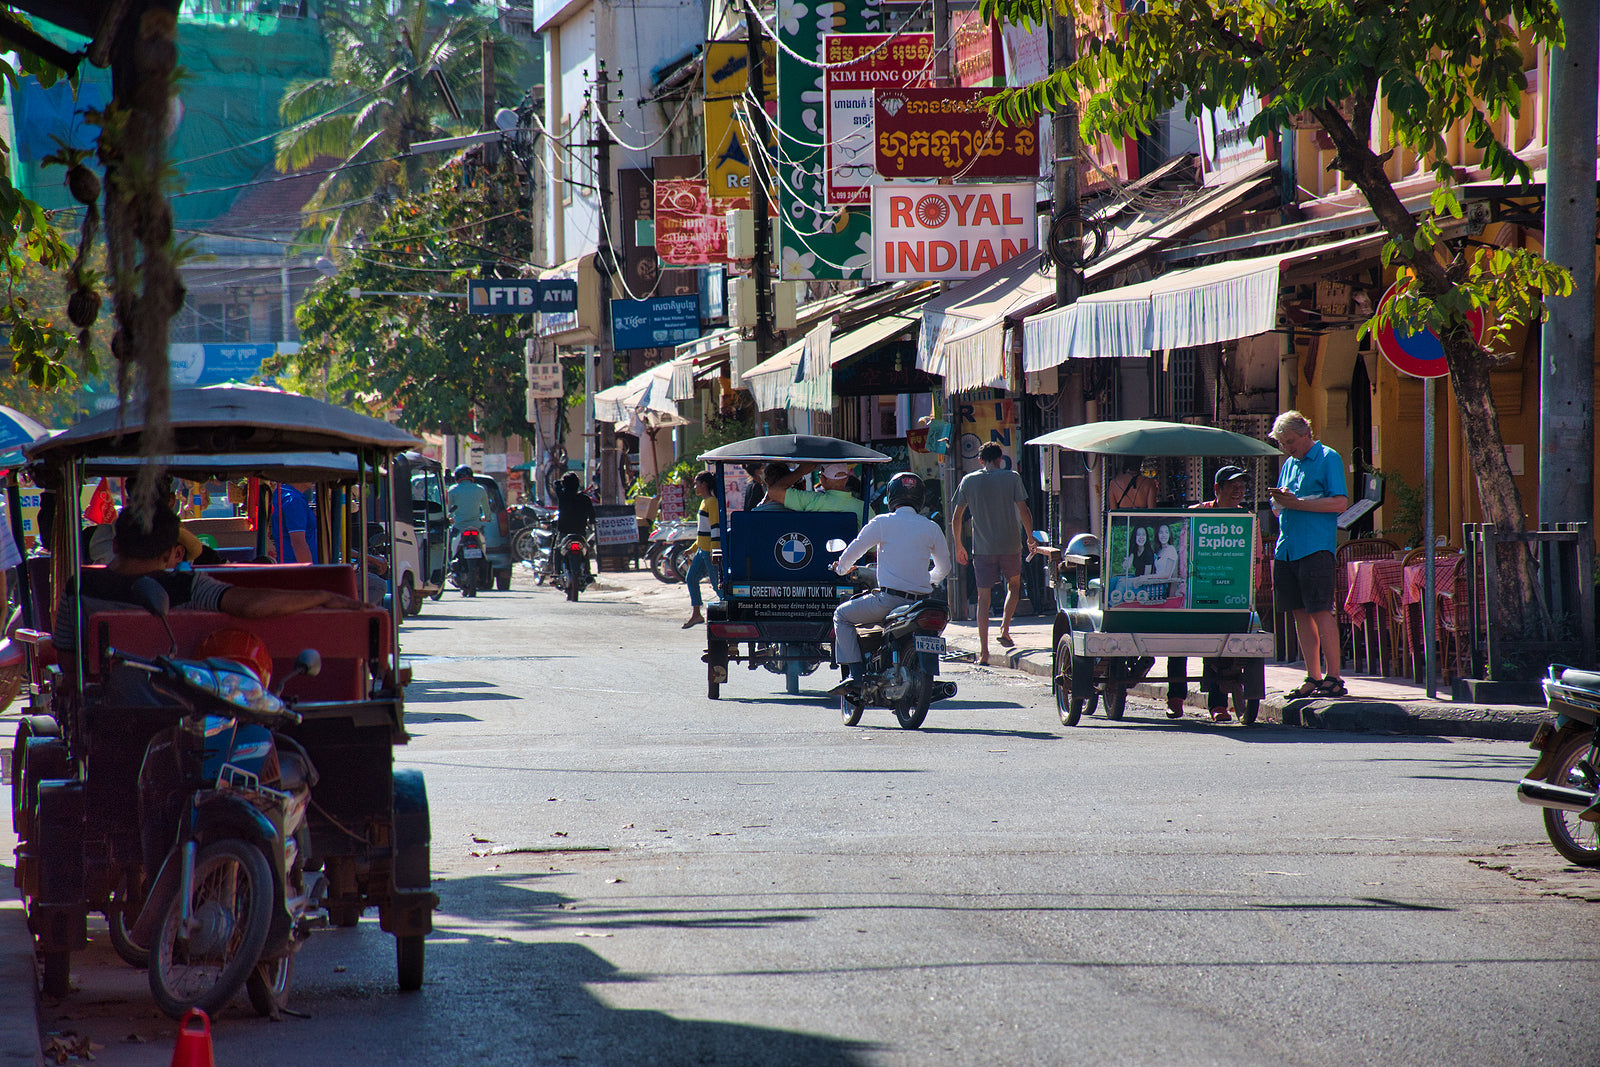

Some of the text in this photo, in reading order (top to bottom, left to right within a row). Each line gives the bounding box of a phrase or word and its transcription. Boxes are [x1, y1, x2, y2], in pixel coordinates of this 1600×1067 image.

[830, 71, 856, 81] KIM
[860, 71, 899, 81] HONG
[889, 193, 1024, 229] ROYAL
[885, 238, 1028, 274] INDIAN
[489, 287, 573, 306] FTB ATM
[623, 315, 648, 328] Tiger
[1198, 523, 1244, 535] Grab to
[1198, 536, 1246, 550] Explore
[751, 586, 834, 598] GREETING TO BMW TUK TUK
[1224, 594, 1247, 605] Grab
[777, 603, 790, 611] your
[806, 602, 820, 611] today
